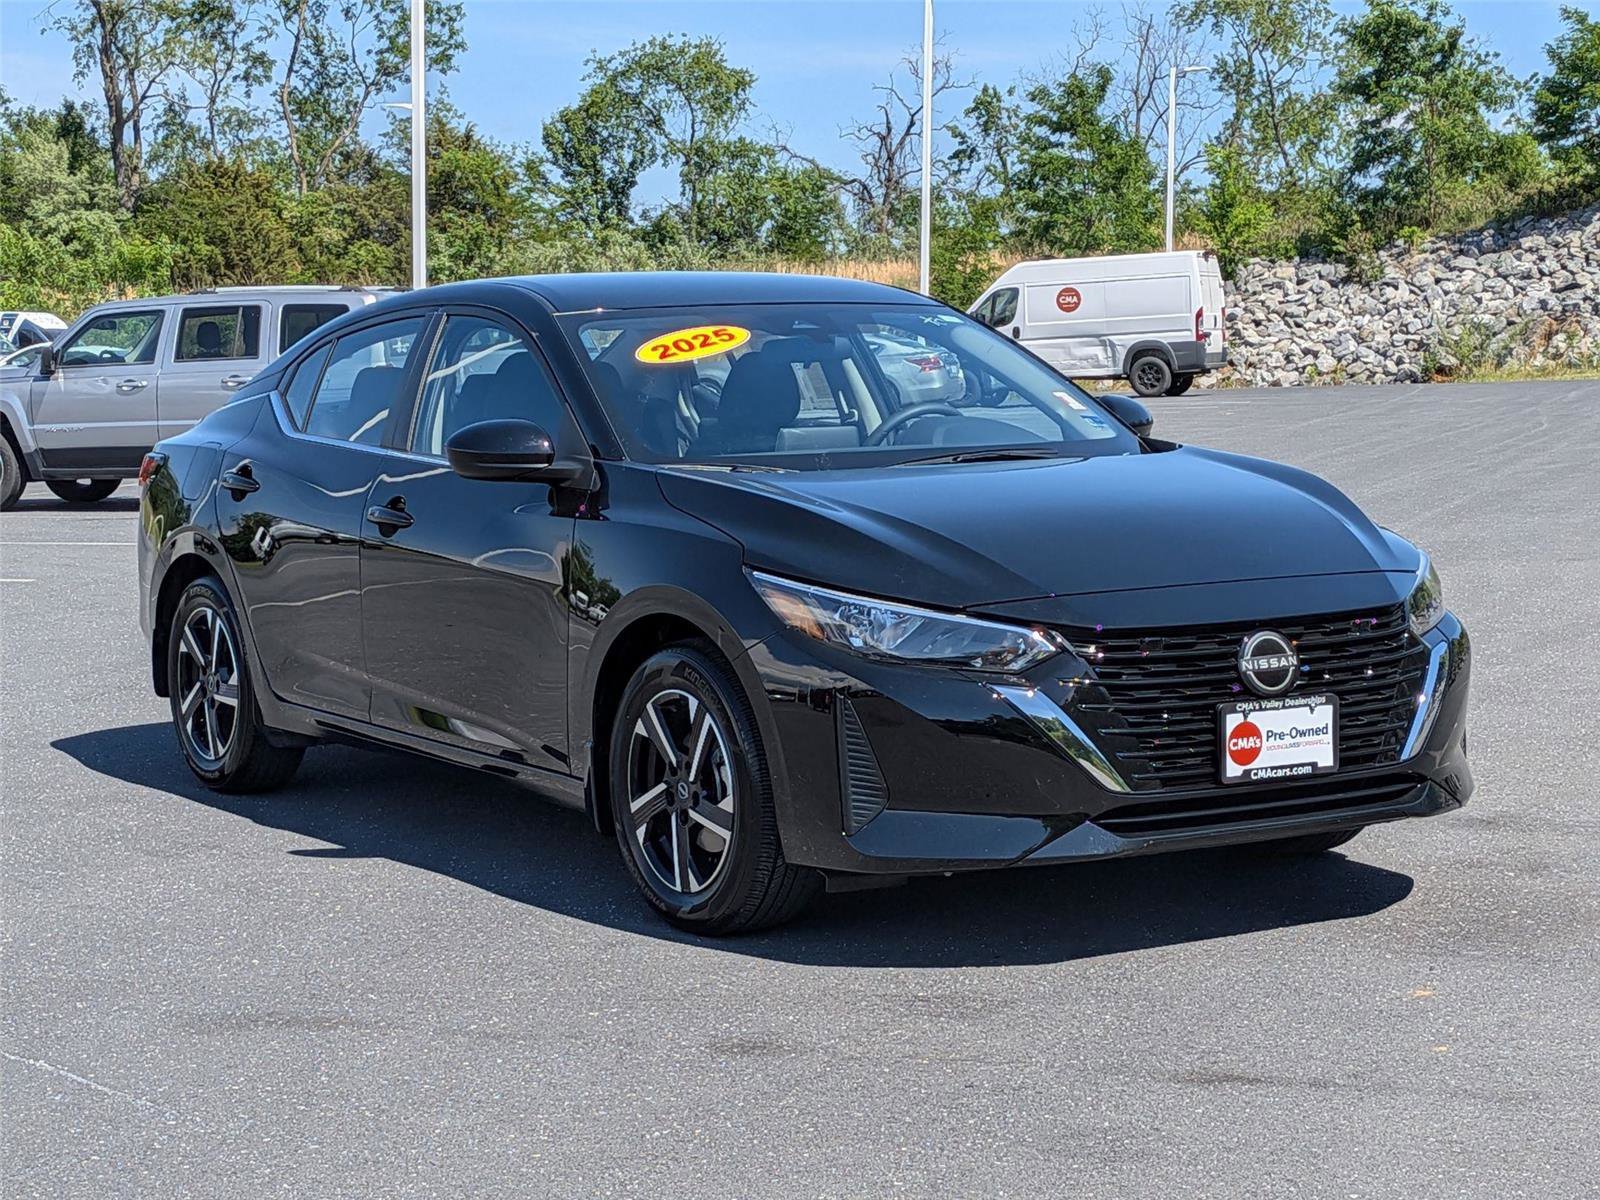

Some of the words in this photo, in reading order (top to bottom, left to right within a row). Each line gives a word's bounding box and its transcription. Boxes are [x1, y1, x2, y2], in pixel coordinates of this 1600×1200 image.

[1059, 295, 1079, 304] CMA
[651, 328, 736, 361] 2025
[1241, 655, 1298, 671] NISSAN
[1261, 699, 1284, 710] Valley
[1285, 695, 1326, 707] Dealerships
[1266, 723, 1329, 742] Pre-Owned
[1229, 736, 1262, 751] CMA's
[1250, 765, 1312, 780] CMAcars.com
